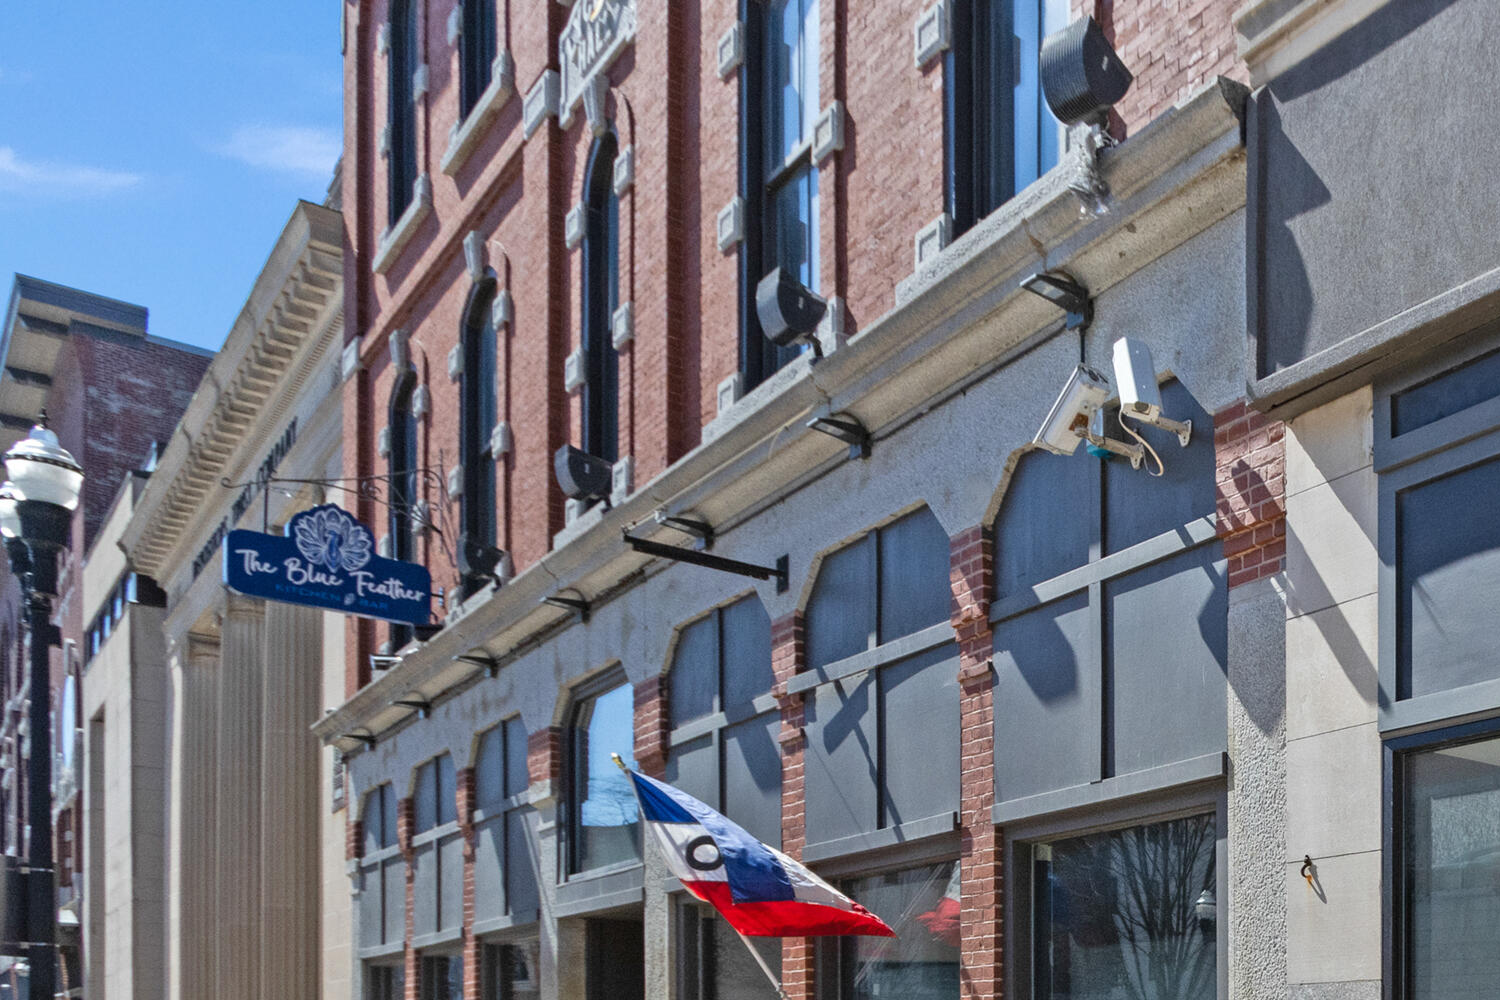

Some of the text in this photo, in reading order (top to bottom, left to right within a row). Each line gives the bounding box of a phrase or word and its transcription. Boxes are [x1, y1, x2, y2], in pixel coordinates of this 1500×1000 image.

[235, 549, 278, 576] The
[284, 557, 343, 586] Blue
[349, 570, 426, 602] Feather
